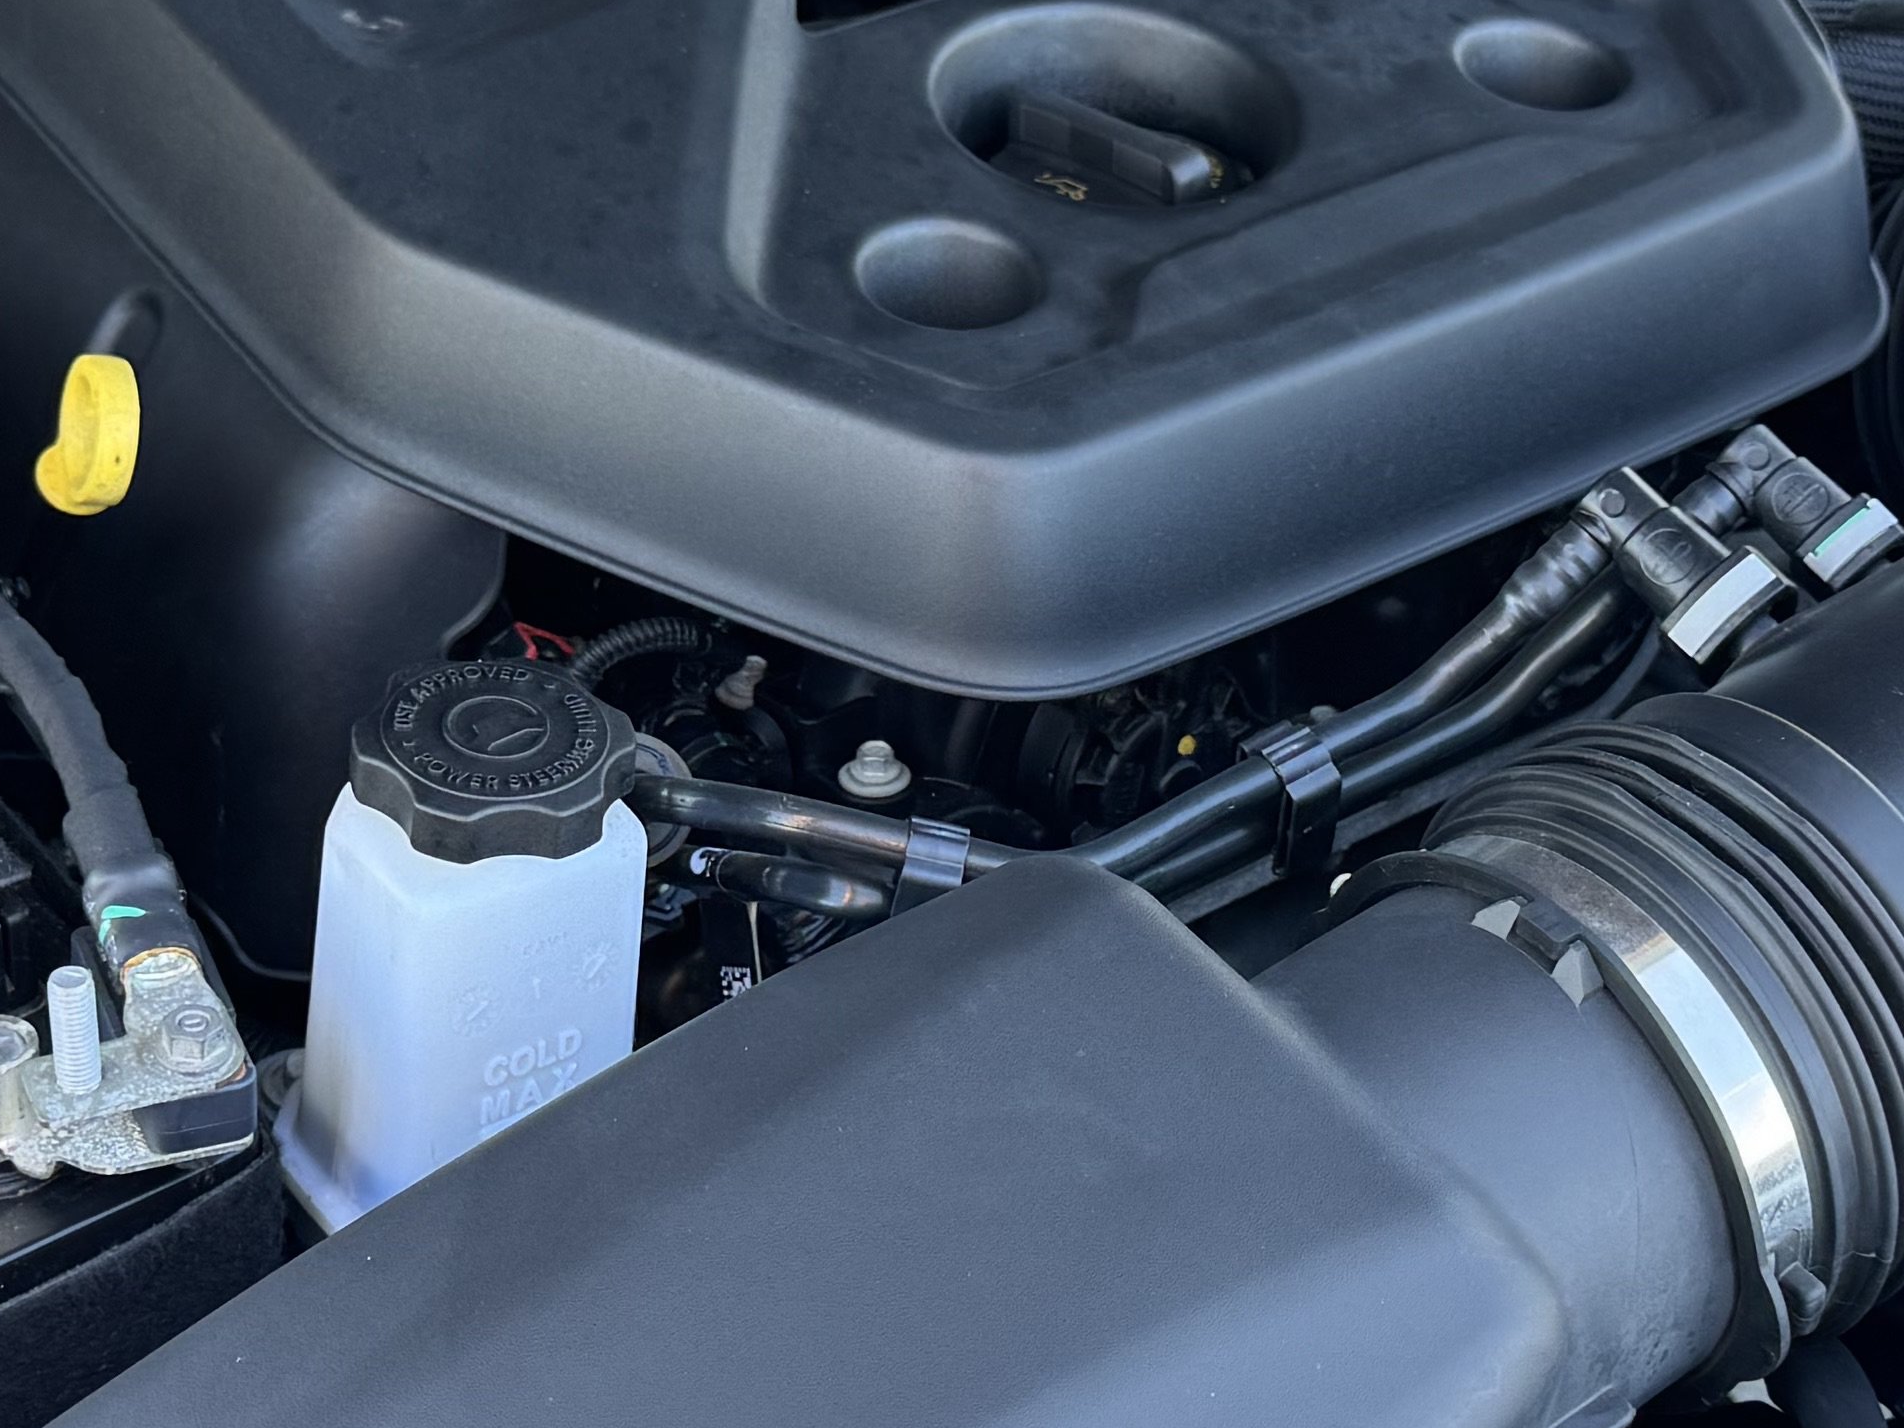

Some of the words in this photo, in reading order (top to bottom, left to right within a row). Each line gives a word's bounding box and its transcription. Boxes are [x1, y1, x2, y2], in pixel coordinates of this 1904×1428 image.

[410, 663, 532, 704] APPROVED
[412, 751, 499, 791] POWER
[507, 737, 598, 789] STEERING
[483, 1028, 583, 1088] COLD
[479, 1061, 578, 1126] MAX
